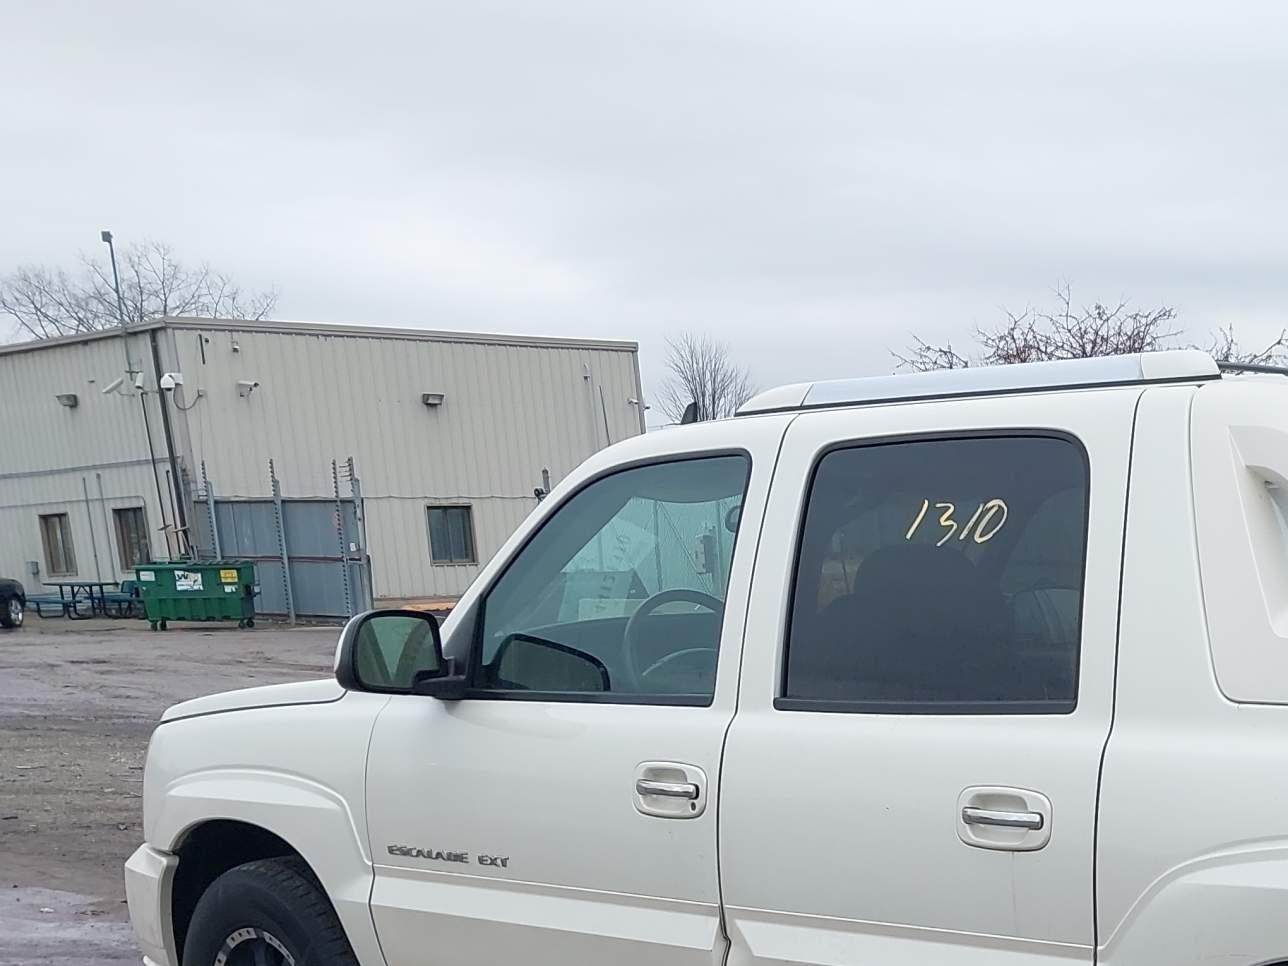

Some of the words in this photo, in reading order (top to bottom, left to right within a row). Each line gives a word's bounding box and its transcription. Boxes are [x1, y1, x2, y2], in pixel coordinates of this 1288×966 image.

[905, 499, 1008, 547] 1310
[387, 844, 469, 864] ESCALADE
[477, 855, 510, 868] EXT
